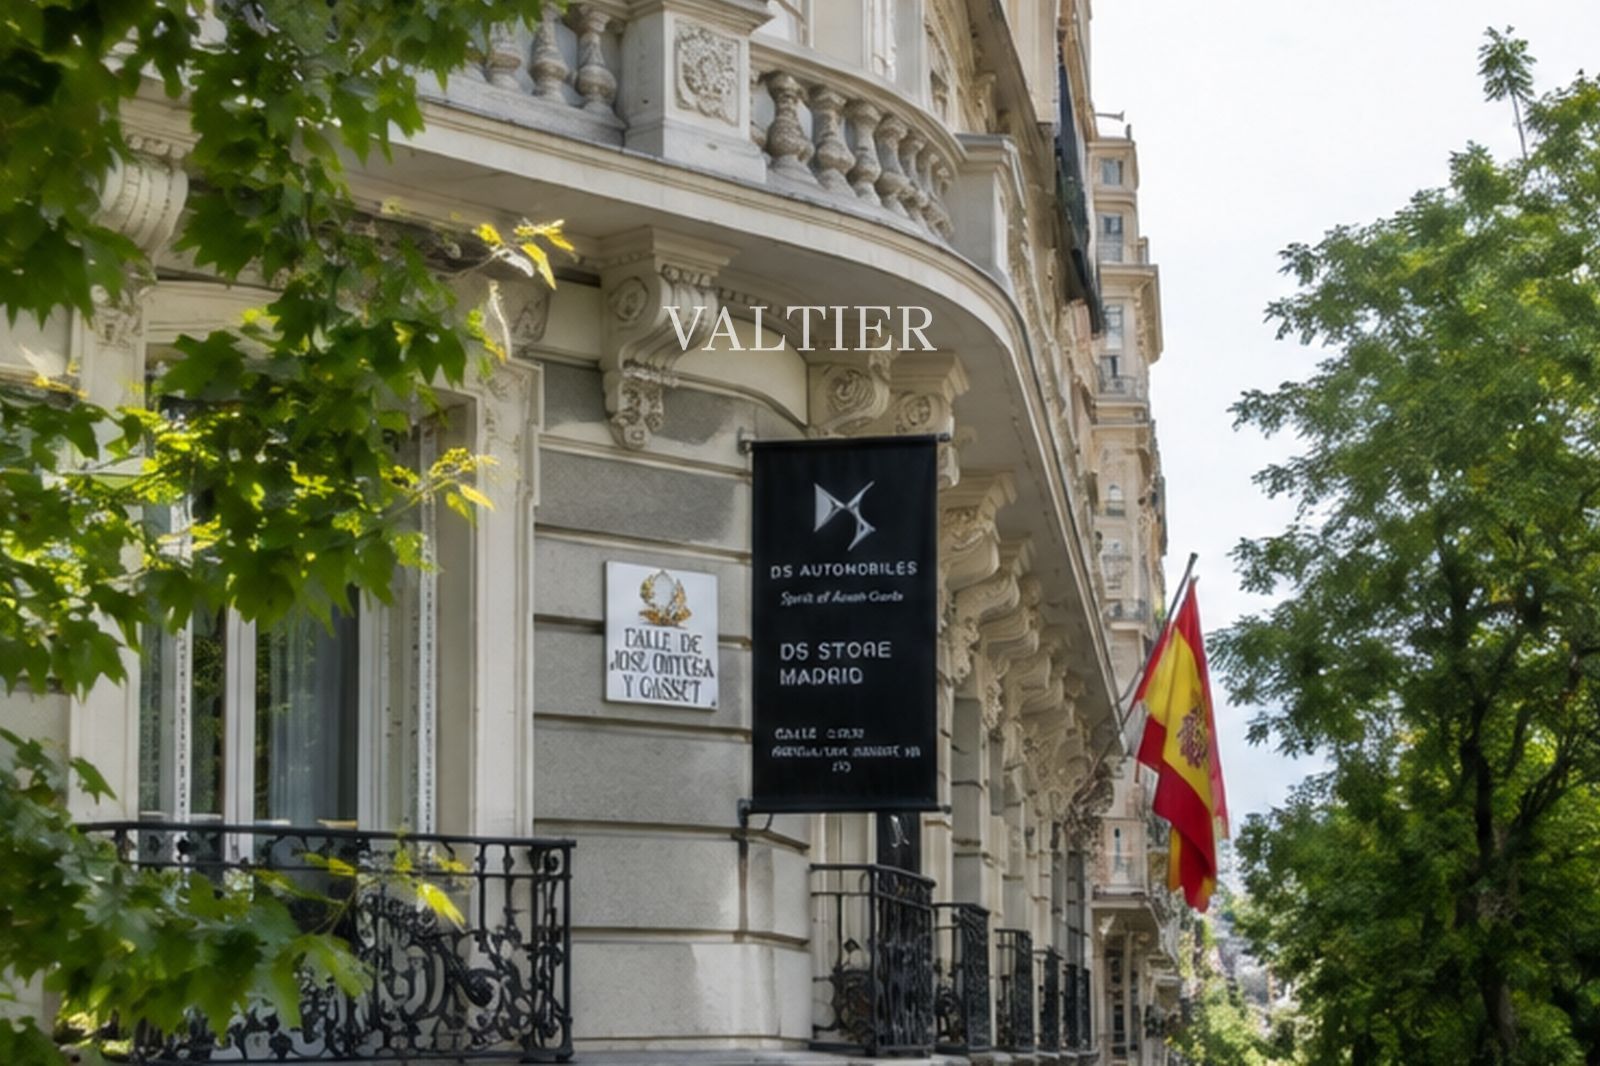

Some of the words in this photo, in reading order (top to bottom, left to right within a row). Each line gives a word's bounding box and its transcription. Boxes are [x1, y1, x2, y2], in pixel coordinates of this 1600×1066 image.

[770, 564, 793, 579] DS
[624, 628, 671, 653] CALLE
[680, 633, 703, 654] DE
[779, 642, 809, 661] DS
[818, 640, 892, 661] STORE
[622, 674, 634, 698] Y
[779, 666, 864, 686] MADRID
